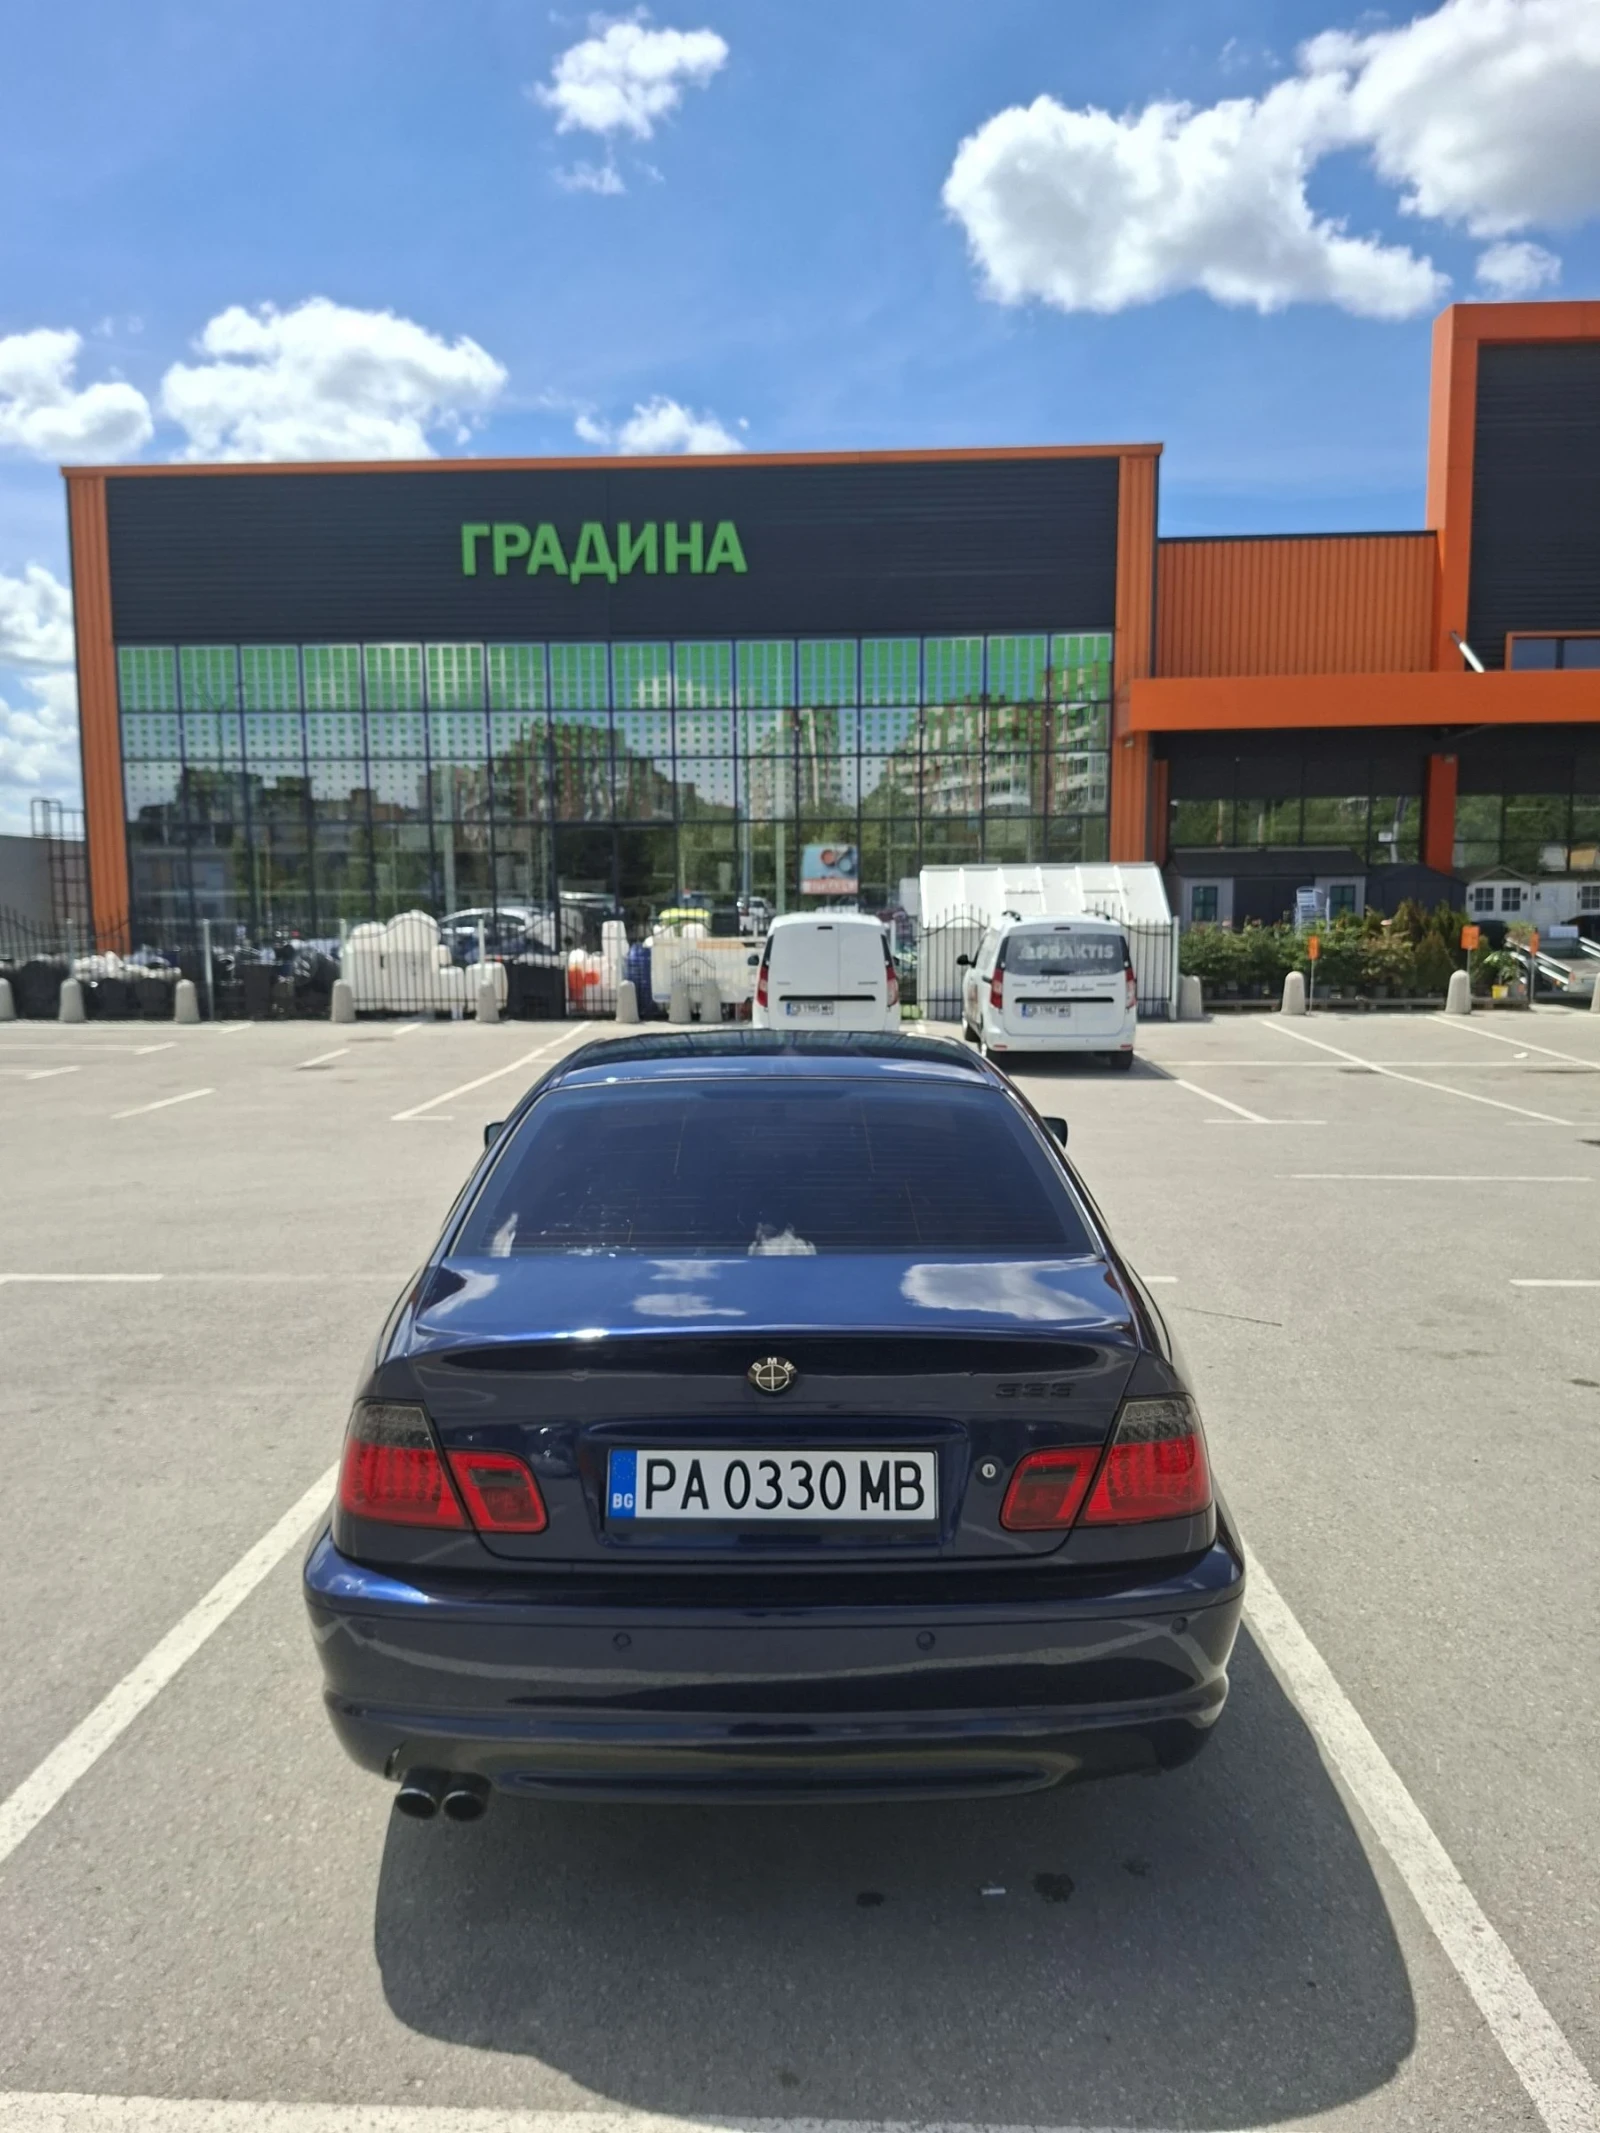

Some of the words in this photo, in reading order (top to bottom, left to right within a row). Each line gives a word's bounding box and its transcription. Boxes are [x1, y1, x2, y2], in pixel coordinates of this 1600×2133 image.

[461, 520, 748, 584] ГРАДИНА
[1037, 944, 1114, 959] PRAKTIS
[751, 1357, 795, 1371] BMW
[645, 1458, 709, 1510] PA
[724, 1459, 846, 1511] 0330
[860, 1460, 925, 1511] MB
[612, 1493, 634, 1509] BG
